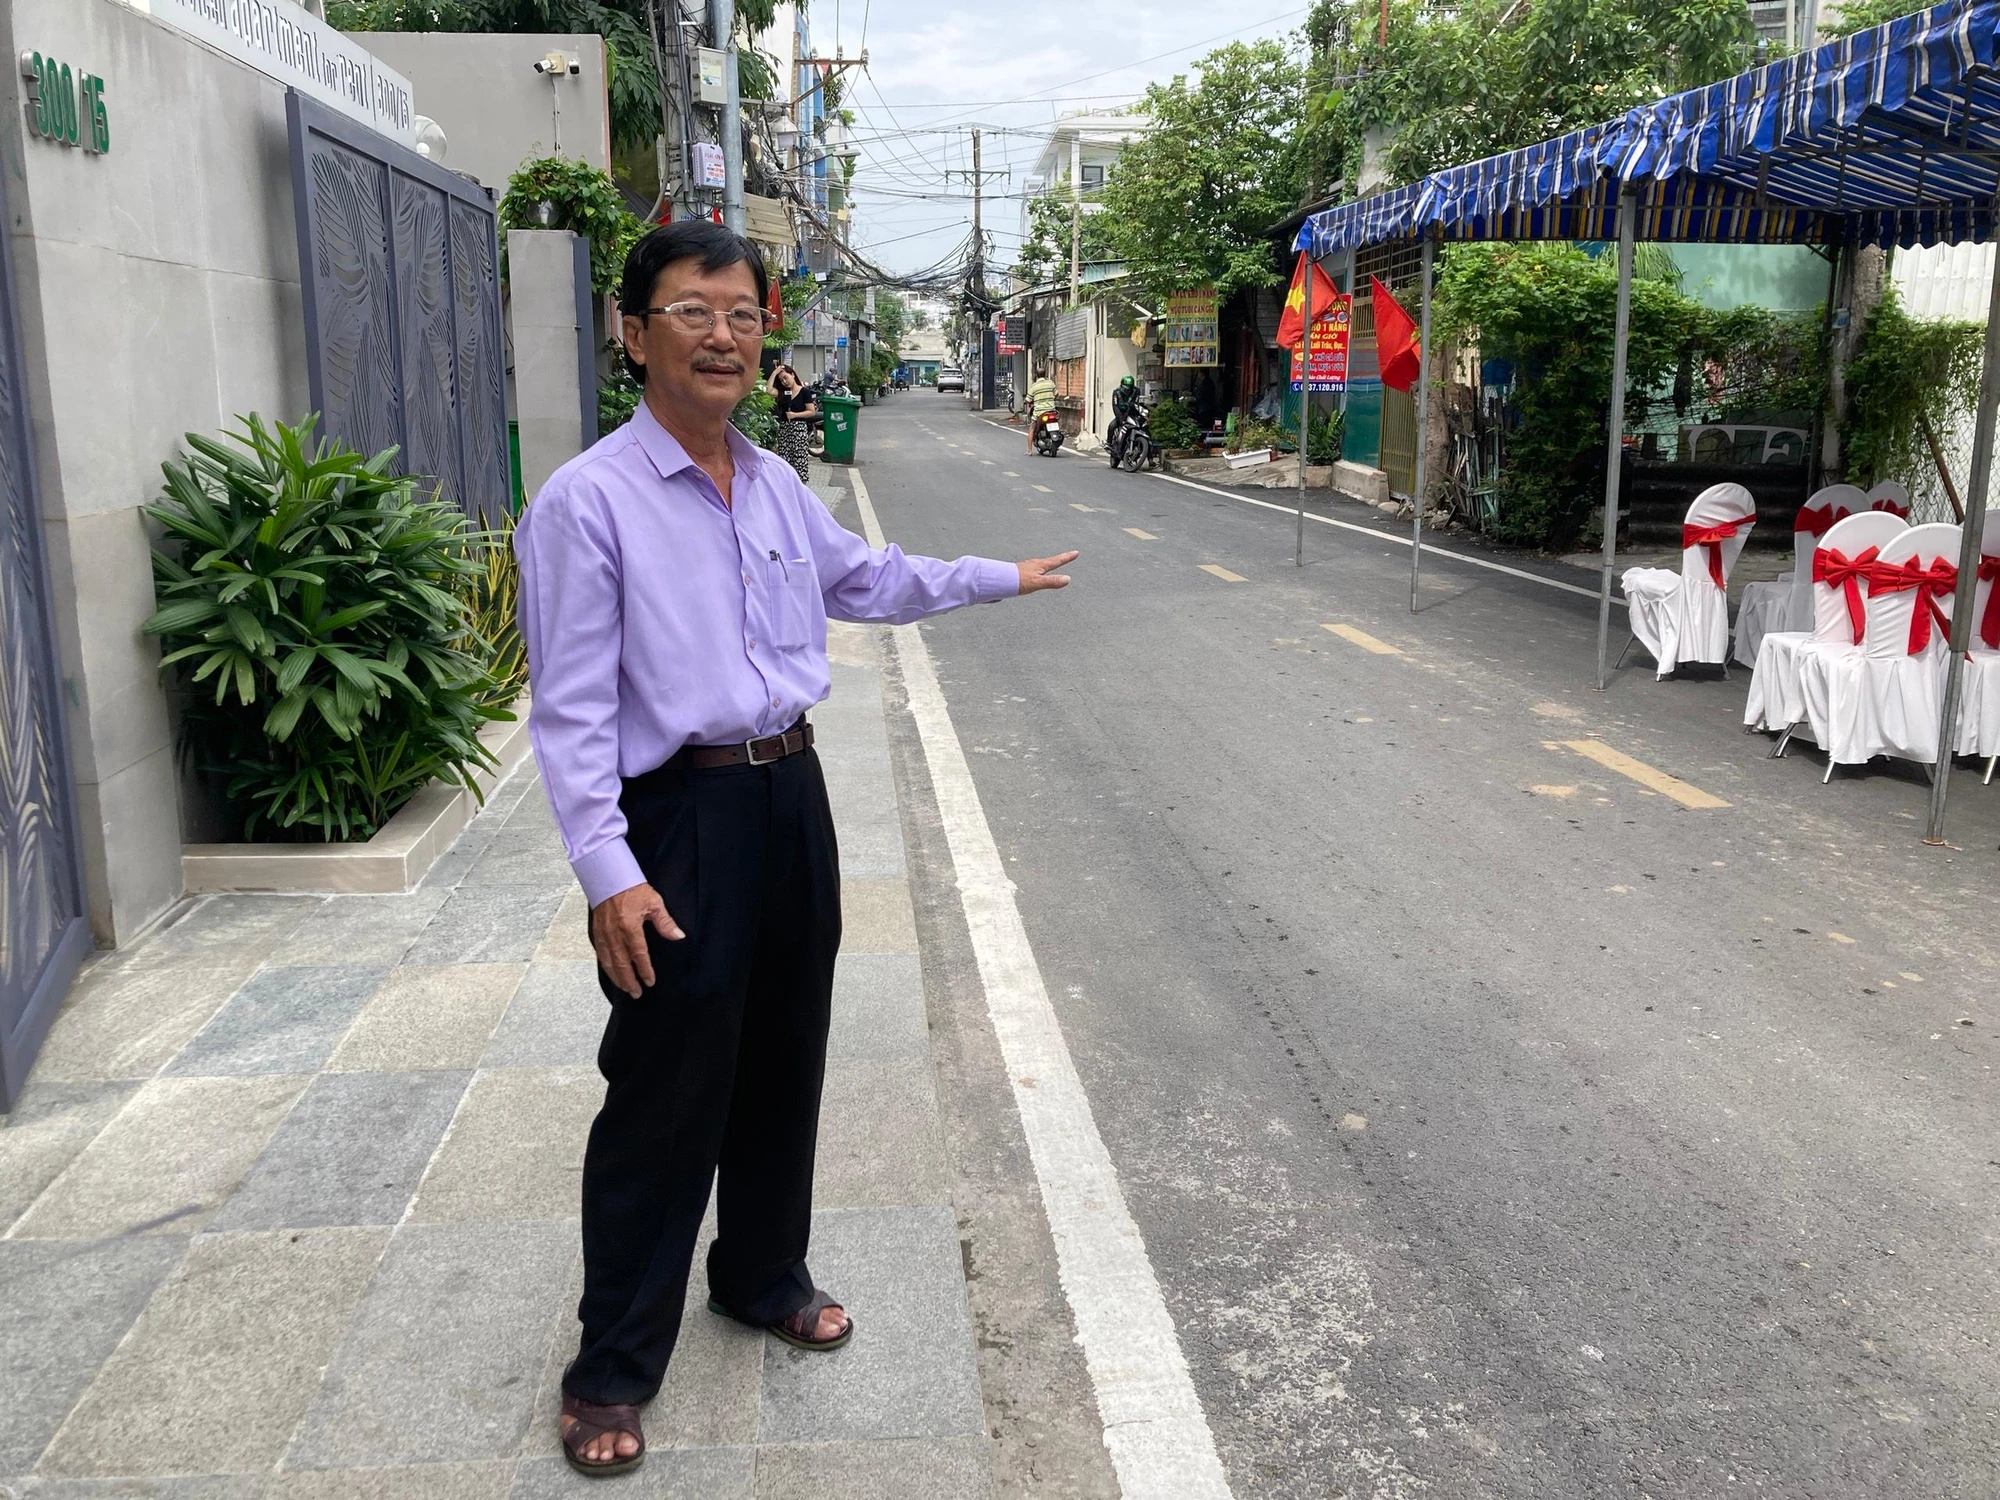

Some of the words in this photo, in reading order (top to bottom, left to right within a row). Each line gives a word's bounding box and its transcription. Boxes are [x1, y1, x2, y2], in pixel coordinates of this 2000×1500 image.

[231, 0, 321, 84] apartment
[321, 52, 338, 92] for
[338, 54, 369, 111] rent
[377, 75, 410, 131] 300/15
[22, 51, 109, 155] 300/15
[1322, 332, 1339, 340] GIỜ
[1329, 321, 1348, 332] NẮNG
